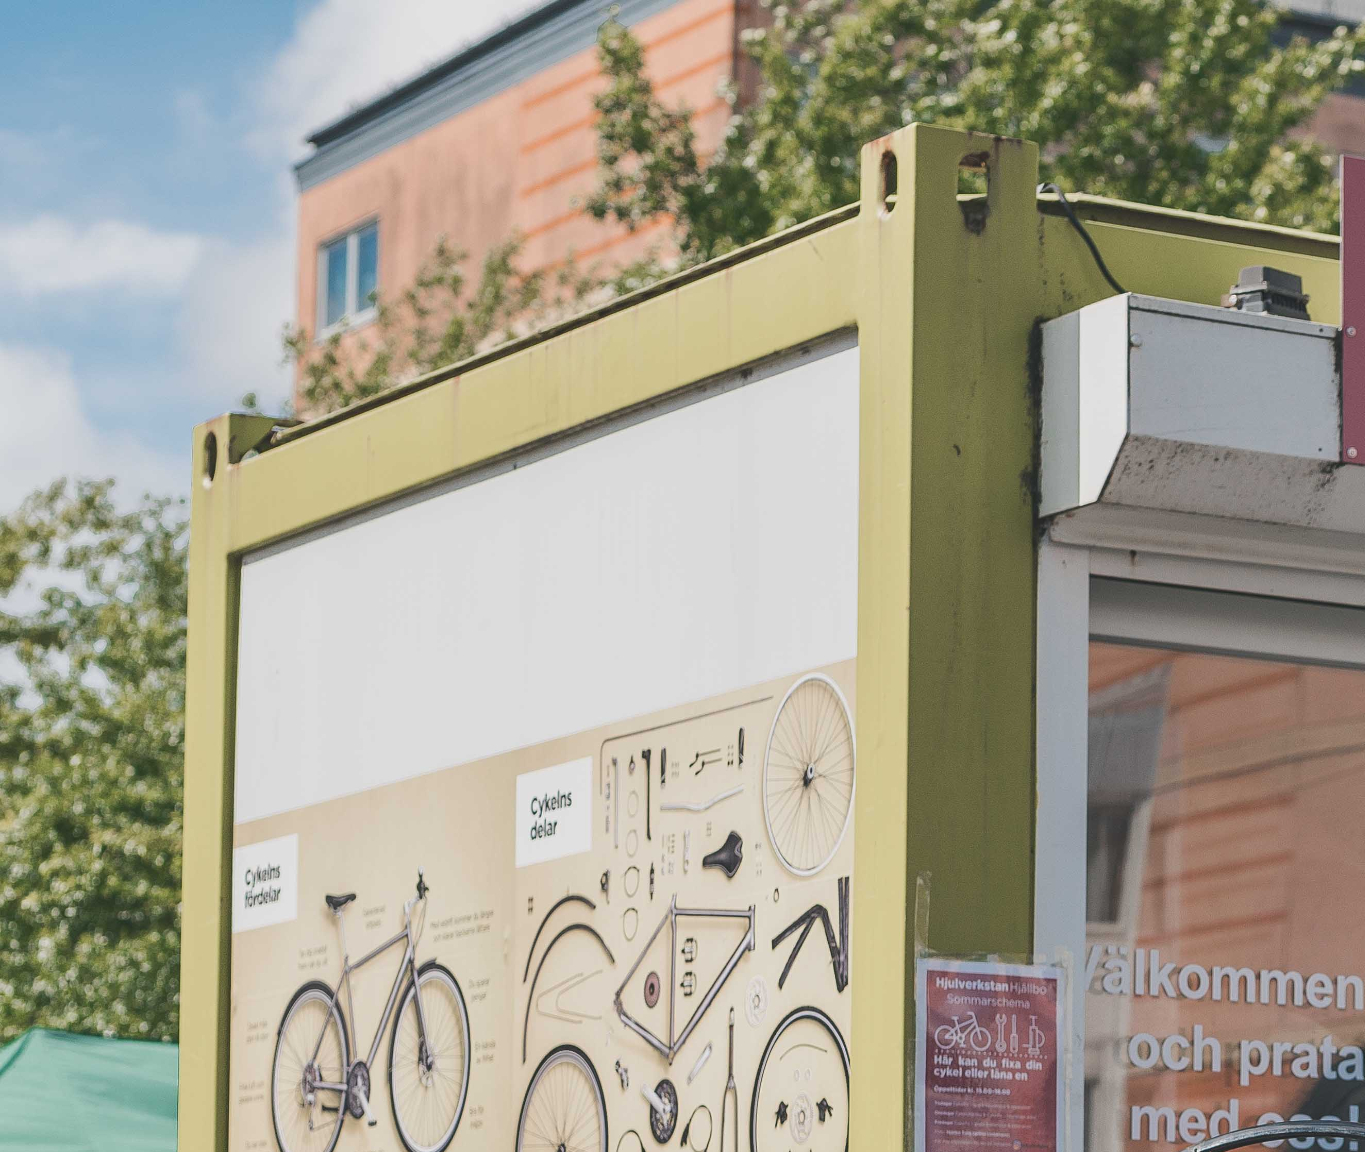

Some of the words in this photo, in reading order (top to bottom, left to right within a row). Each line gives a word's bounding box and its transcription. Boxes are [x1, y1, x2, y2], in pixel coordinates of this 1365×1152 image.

[530, 789, 572, 818] Cykelns
[530, 819, 558, 841] delar
[245, 862, 281, 888] Cykelns
[244, 885, 281, 909] fördelar
[936, 977, 1009, 992] Hjulverkstan
[1010, 982, 1048, 995] Hjällbo
[947, 993, 1031, 1009] Sommarschema
[934, 1055, 953, 1066] Här
[958, 1056, 978, 1067] kan
[983, 1057, 997, 1068] du
[1001, 1058, 1021, 1069] fixa
[1025, 1060, 1042, 1070] din
[1128, 1024, 1222, 1073] och
[1239, 1035, 1365, 1087] prata
[933, 1066, 963, 1079] cykel
[964, 1068, 989, 1079] eller
[990, 1069, 1013, 1080] låna
[1014, 1072, 1028, 1081] en
[1131, 1098, 1240, 1145] med
